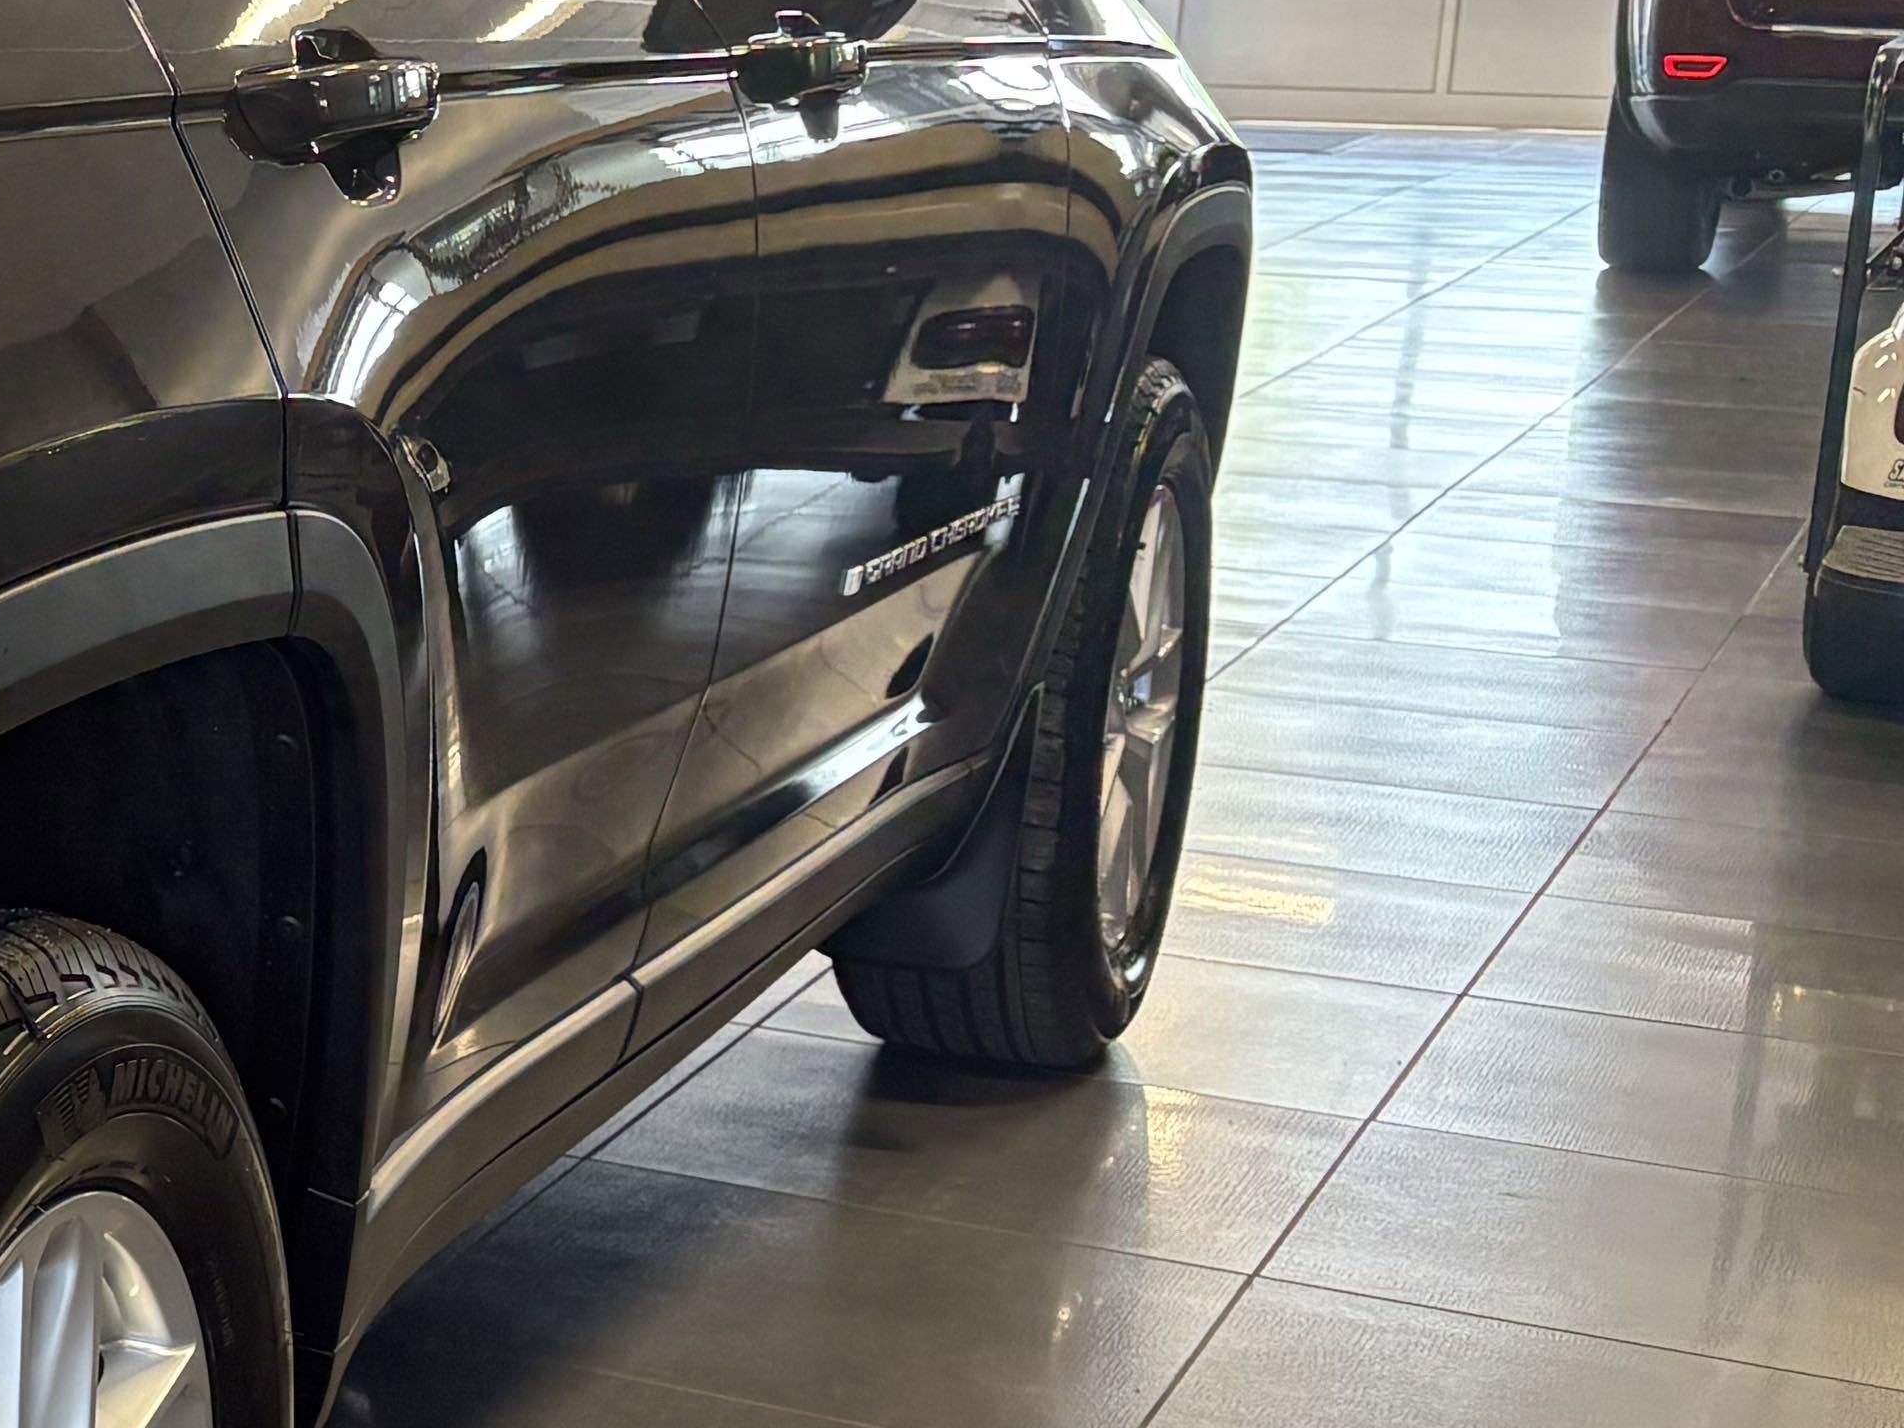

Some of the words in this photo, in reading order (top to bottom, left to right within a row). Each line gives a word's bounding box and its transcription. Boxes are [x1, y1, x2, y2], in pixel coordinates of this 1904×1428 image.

[865, 535, 928, 585] GRAND
[930, 495, 1022, 553] CHEROKEE
[109, 1057, 238, 1158] MICHELIN
